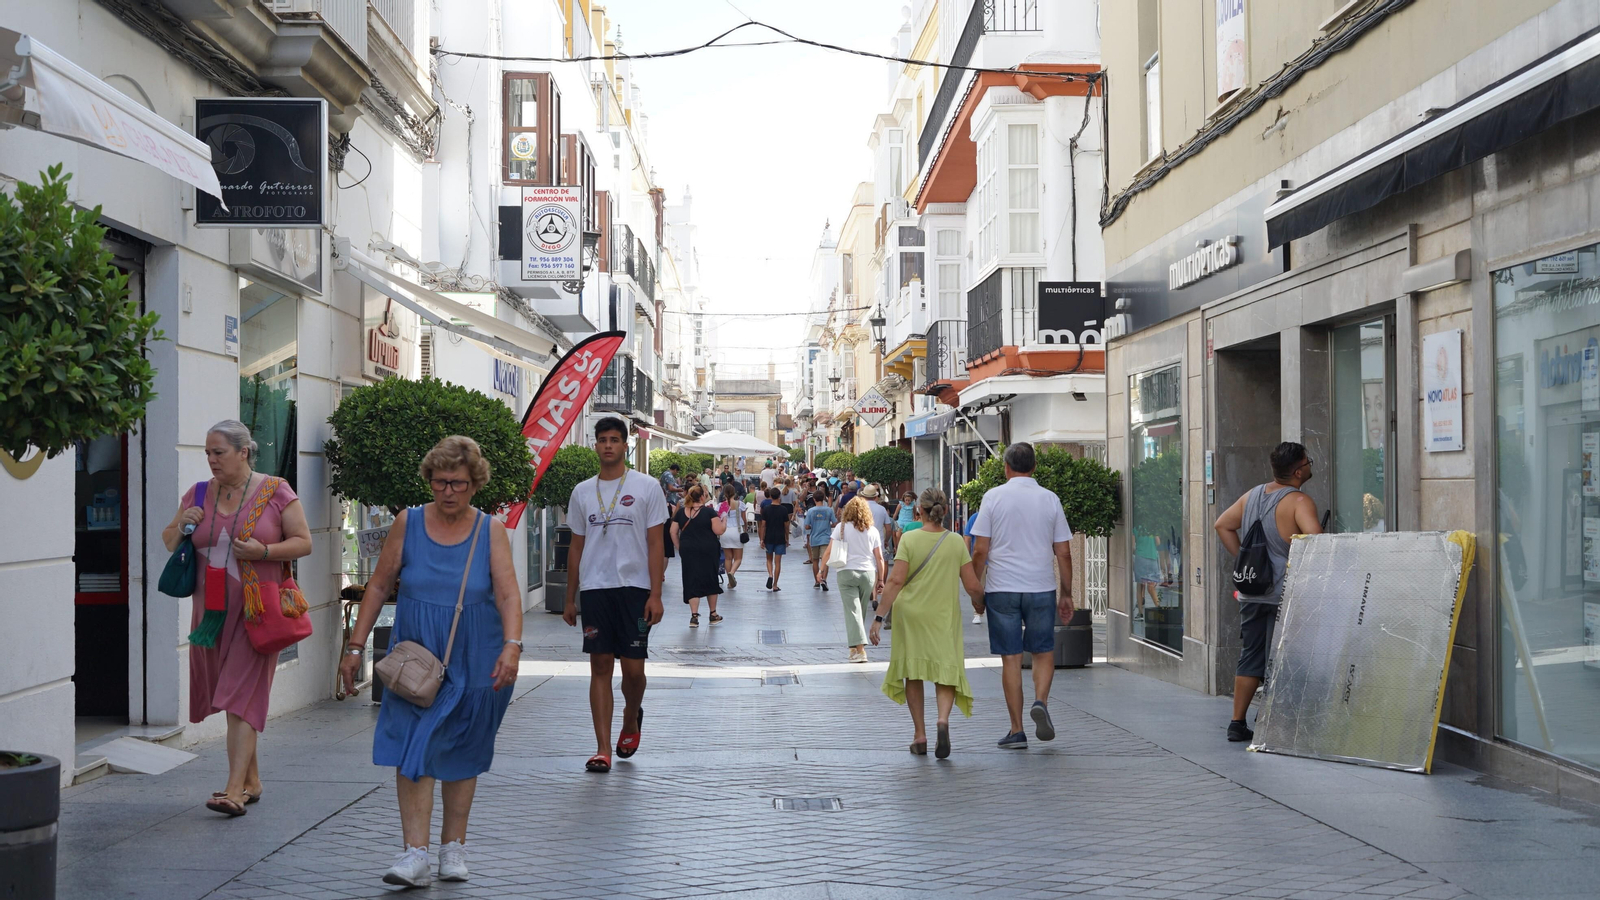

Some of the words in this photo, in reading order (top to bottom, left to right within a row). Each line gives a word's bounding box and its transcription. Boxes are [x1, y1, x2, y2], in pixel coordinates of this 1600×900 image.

[524, 195, 564, 203] FORMACIÓN
[212, 205, 306, 218] ASTROFOTO
[534, 207, 570, 220] AUTOESCUELA
[365, 530, 390, 541] TOD
[1358, 572, 1372, 625] CLIMAVER
